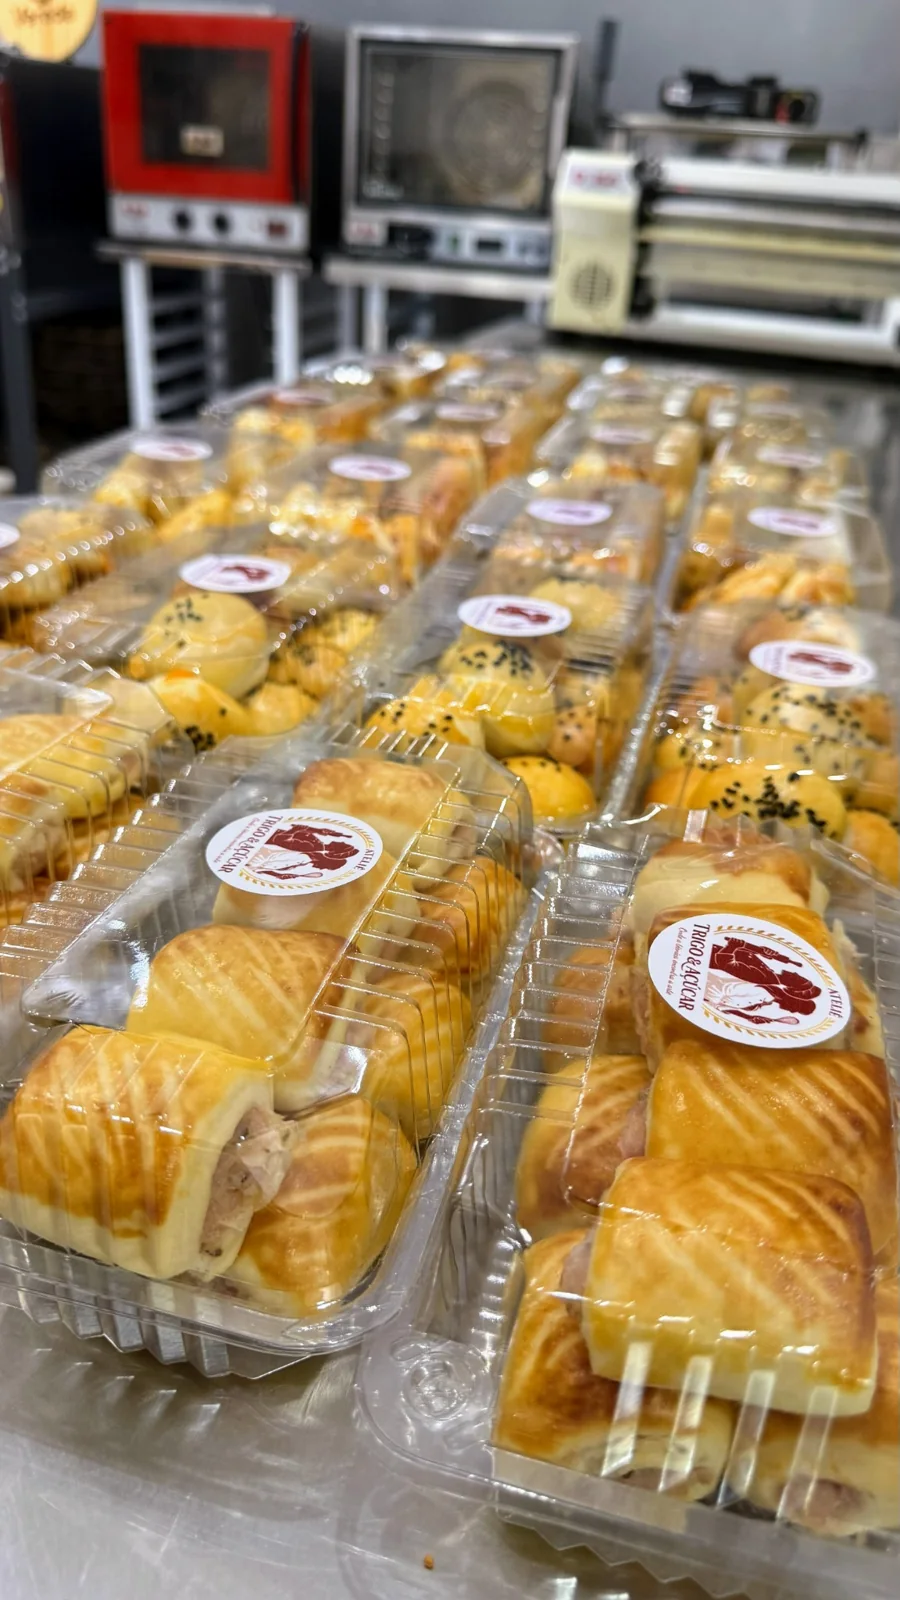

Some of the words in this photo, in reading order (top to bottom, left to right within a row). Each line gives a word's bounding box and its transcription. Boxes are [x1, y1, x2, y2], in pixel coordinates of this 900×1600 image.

[253, 815, 284, 838] TRIGO
[217, 842, 255, 873] AÇÚCAR
[688, 924, 710, 957] TRIGO
[680, 956, 702, 971] &
[678, 965, 702, 1011] AÇÚCAR
